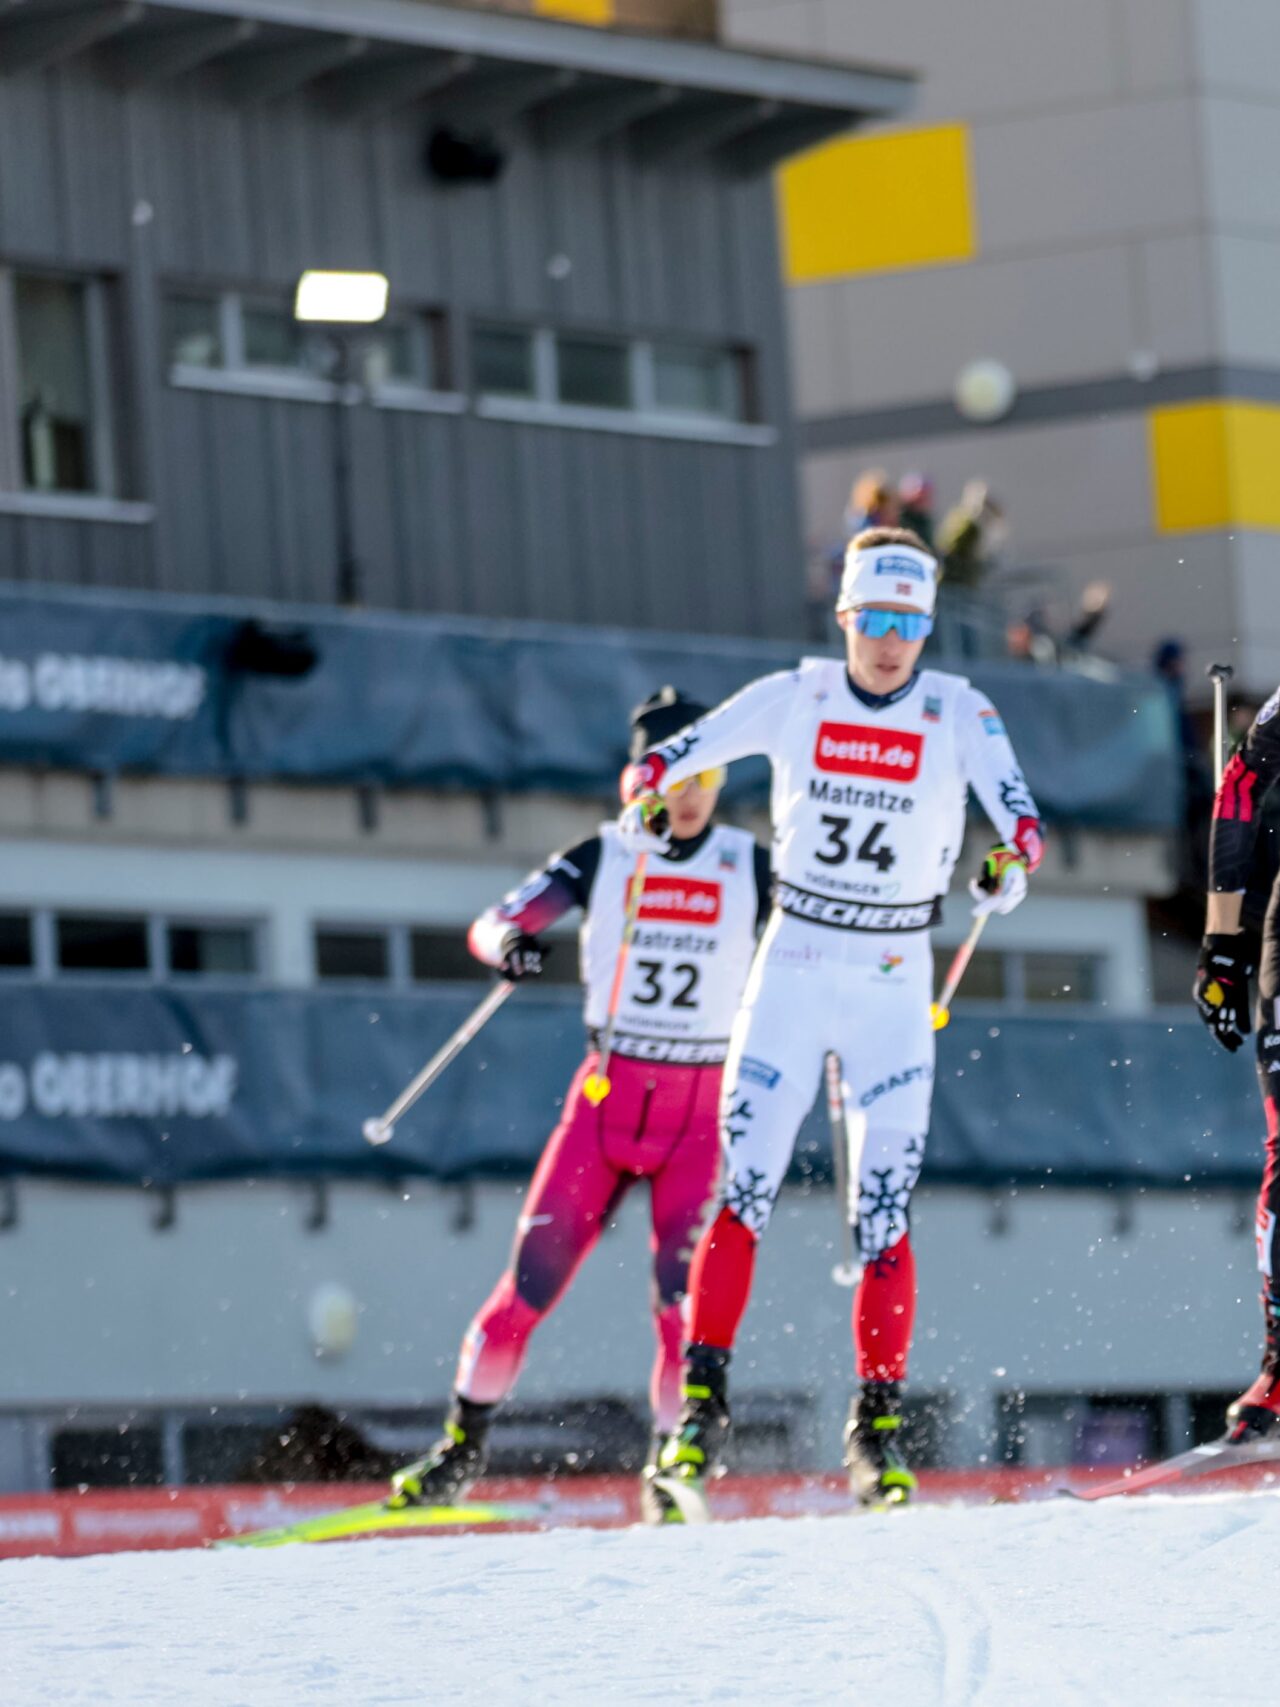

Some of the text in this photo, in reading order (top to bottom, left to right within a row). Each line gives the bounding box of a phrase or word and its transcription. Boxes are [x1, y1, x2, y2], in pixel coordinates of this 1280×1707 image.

[819, 735, 915, 769] bett1.de
[808, 779, 915, 814] Matratze
[814, 813, 897, 873] 34
[632, 959, 700, 1009] 32
